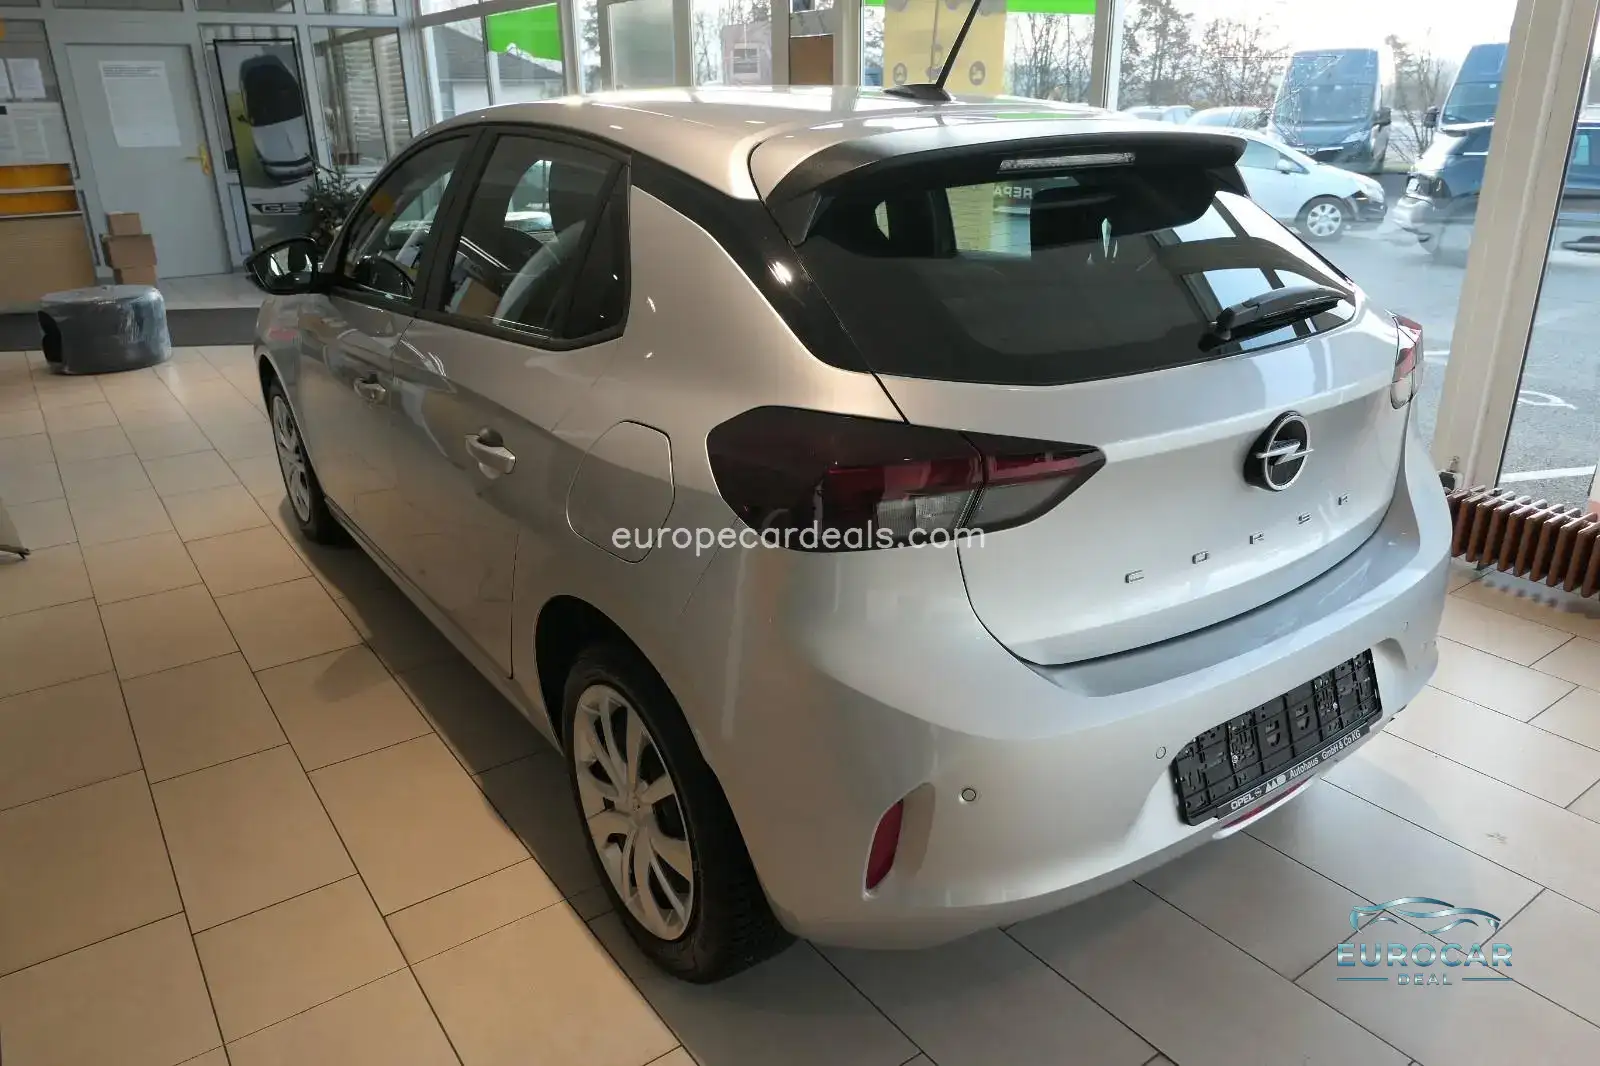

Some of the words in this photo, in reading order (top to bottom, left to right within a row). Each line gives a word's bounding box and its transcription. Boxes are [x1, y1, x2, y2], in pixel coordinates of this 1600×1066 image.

[1231, 794, 1254, 809] OPEL
[1289, 758, 1319, 780] Autohaus
[1321, 742, 1339, 759] GmbH
[1352, 730, 1361, 741] KG
